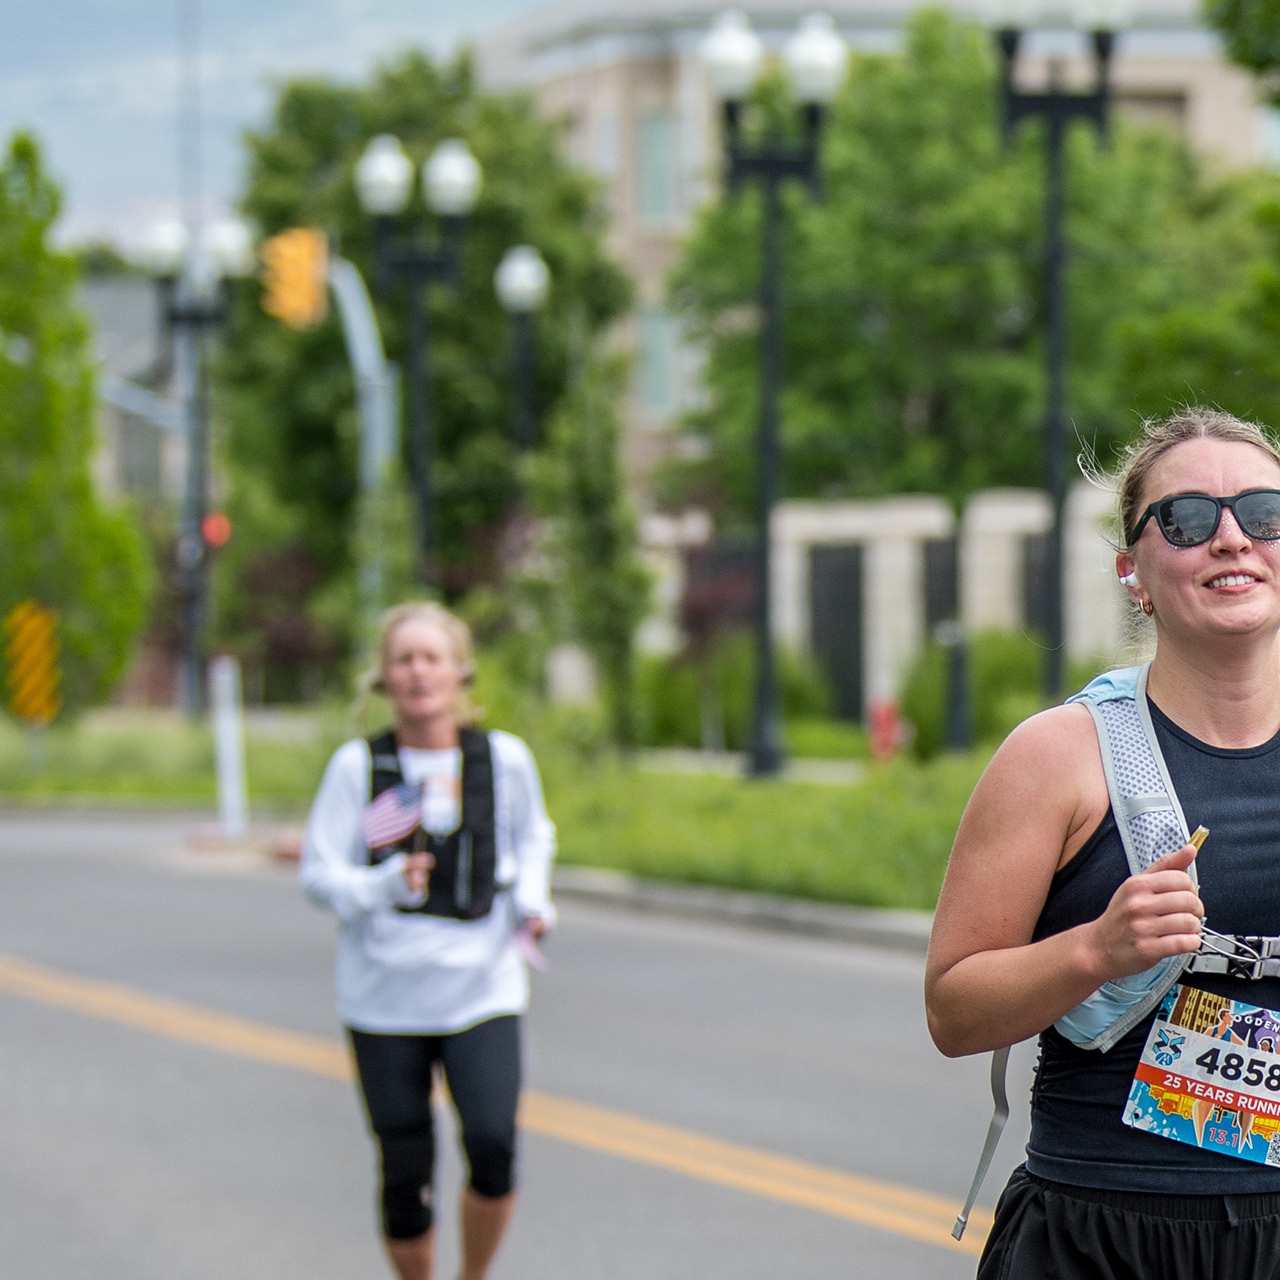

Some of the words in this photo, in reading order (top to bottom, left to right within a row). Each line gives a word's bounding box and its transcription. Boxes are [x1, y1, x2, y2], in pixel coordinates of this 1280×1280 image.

[1234, 1015, 1280, 1033] OGDEN
[1163, 1074, 1182, 1090] 25
[1186, 1081, 1234, 1104] YEARS
[1208, 1128, 1238, 1148] 13.1
